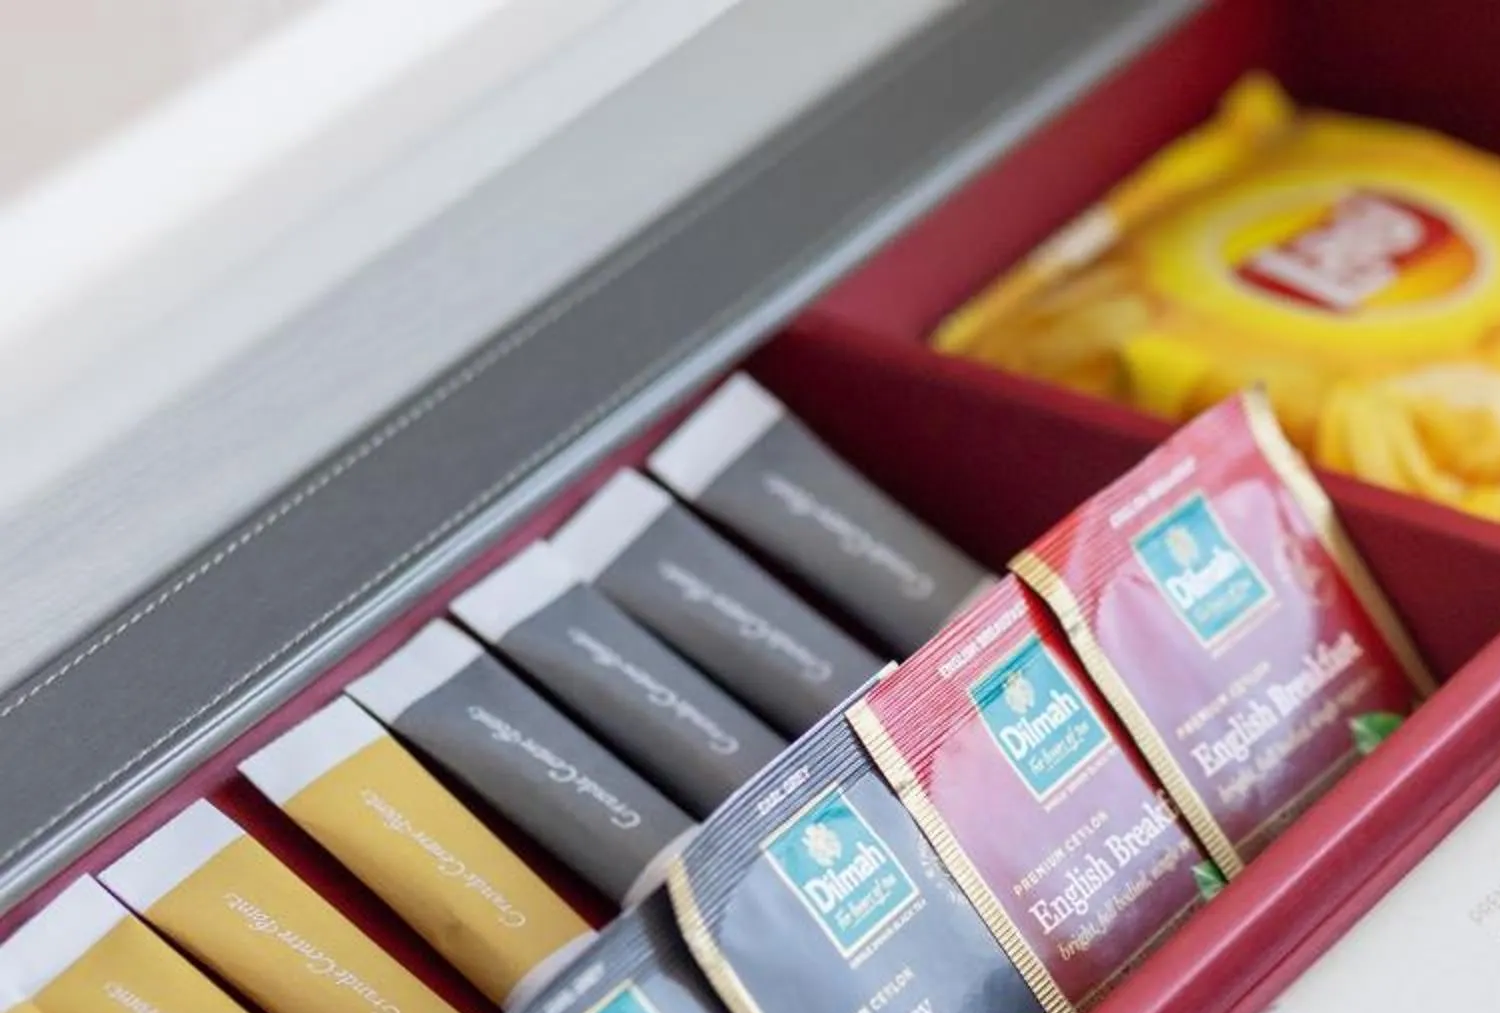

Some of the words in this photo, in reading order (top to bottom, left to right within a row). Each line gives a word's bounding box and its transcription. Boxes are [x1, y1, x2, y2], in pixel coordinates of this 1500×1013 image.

[998, 689, 1080, 760] Dilmah
[1188, 693, 1279, 778] English
[803, 841, 887, 914] Dilmah
[1011, 847, 1066, 896] PREMIUM
[1062, 810, 1109, 853] CEYLON
[1027, 846, 1116, 936] English
[276, 927, 335, 973] Centre
[868, 965, 915, 1011] CEYLON
